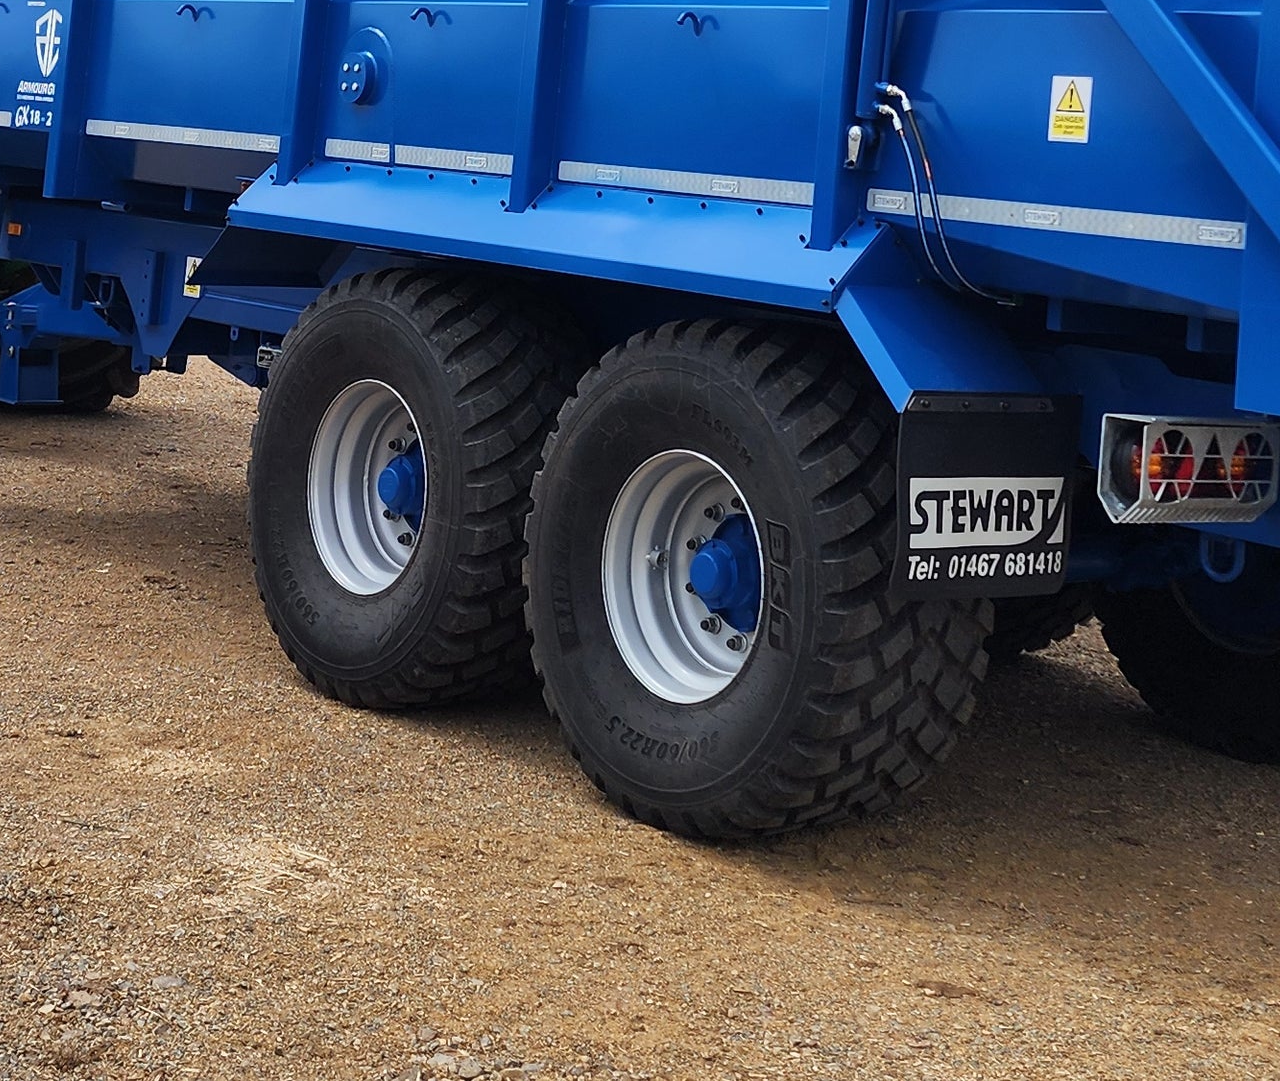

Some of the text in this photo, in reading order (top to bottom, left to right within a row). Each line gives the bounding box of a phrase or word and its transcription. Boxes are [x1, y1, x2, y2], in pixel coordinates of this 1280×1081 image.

[910, 489, 1065, 544] STEWART
[908, 551, 1063, 580] Tel: 01467 681418
